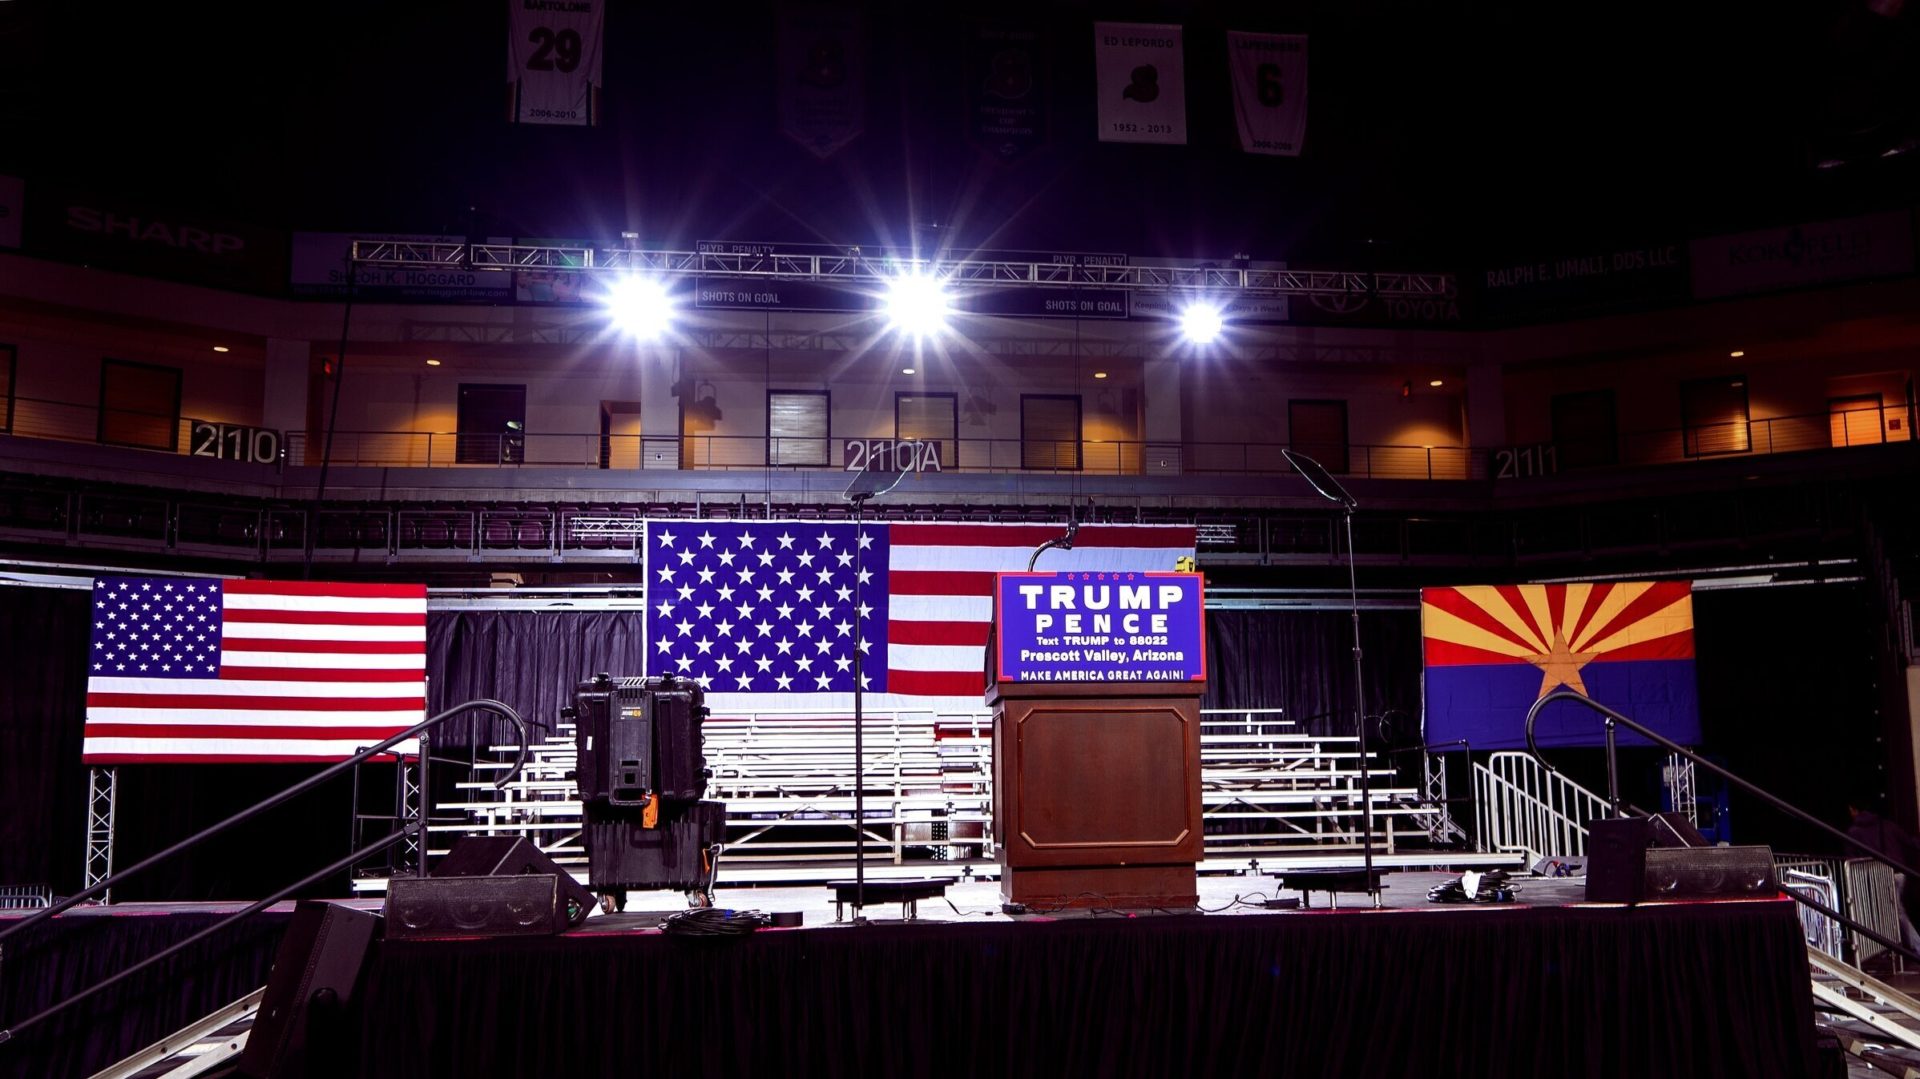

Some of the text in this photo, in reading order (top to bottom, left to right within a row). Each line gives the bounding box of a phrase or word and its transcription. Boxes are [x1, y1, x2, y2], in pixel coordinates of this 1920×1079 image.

[1104, 36, 1174, 48] ED LEPORDO
[527, 27, 582, 73] 29
[1258, 64, 1283, 107] 6
[530, 109, 577, 119] 2006-2010
[1113, 123, 1137, 132] 1952
[1147, 125, 1172, 133] 2013
[66, 205, 246, 254] SHARP
[1486, 265, 1534, 288] RALPH
[1538, 264, 1551, 281] E.
[1612, 249, 1646, 271] DDS
[1649, 244, 1681, 266] LLC
[406, 272, 476, 286] HOGGARD
[702, 291, 781, 304] SHOTS ON GOAL
[1045, 300, 1122, 312] SHOTS ON GOAL
[1384, 299, 1461, 320] TOYOTA
[1019, 585, 1183, 610] TRUMP
[1035, 613, 1168, 634] PENCE
[1036, 636, 1168, 645] Text TRUMP to 88022
[1021, 649, 1184, 664] Prescott Valley, Arizona
[1021, 670, 1184, 680] MAKE AMERICA GREAT AGAIN!
